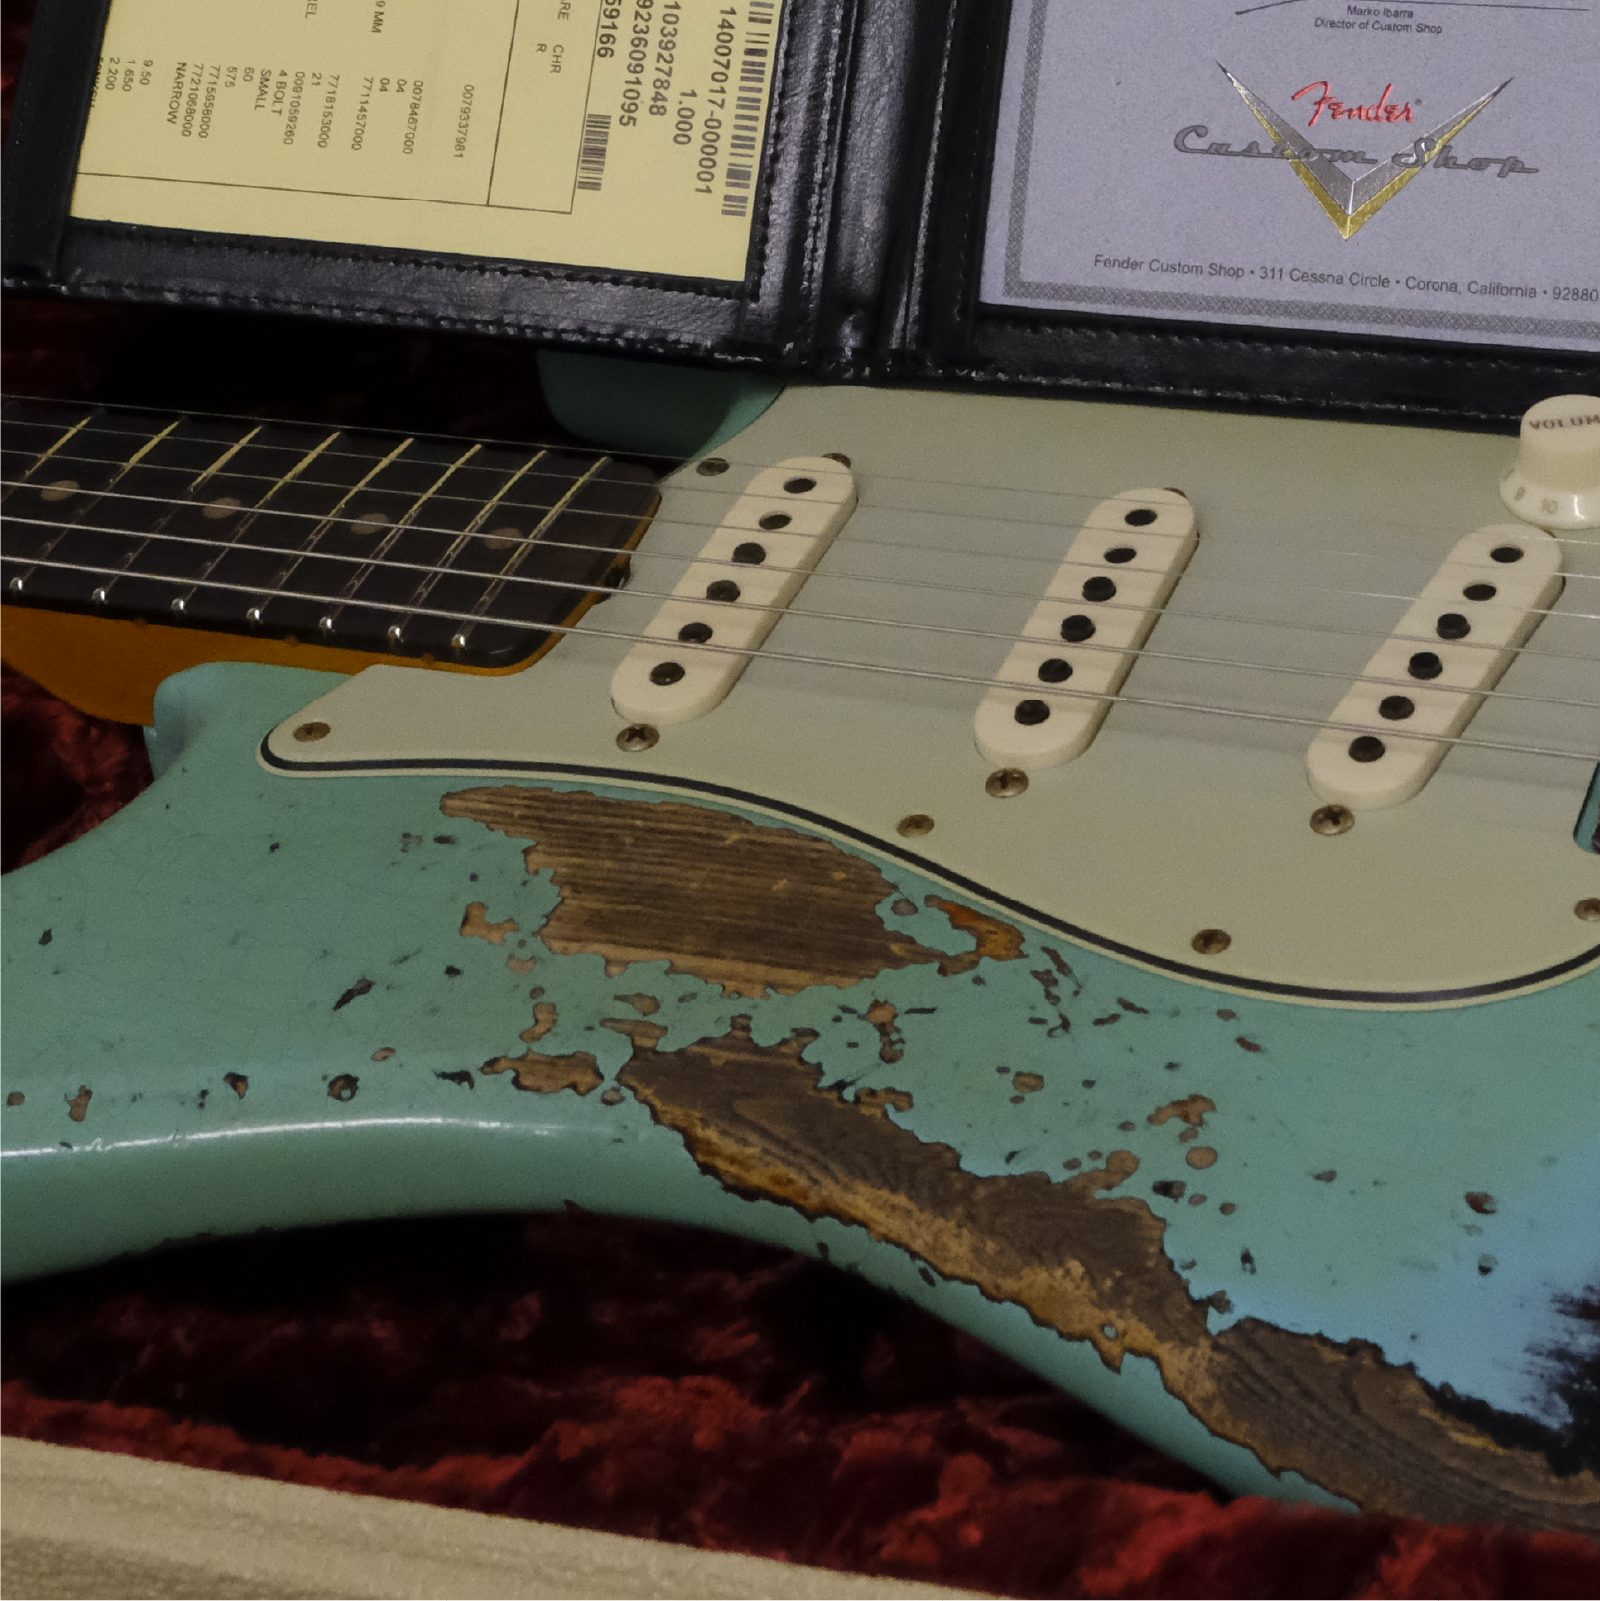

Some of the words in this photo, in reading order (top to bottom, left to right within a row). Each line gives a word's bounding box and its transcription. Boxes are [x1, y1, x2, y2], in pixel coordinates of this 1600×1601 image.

[1313, 16, 1356, 29] Director
[1357, 19, 1369, 29] of
[1371, 19, 1412, 32] Custom
[1346, 4, 1380, 16] Marko
[1382, 7, 1413, 18] Ibarra
[549, 43, 564, 73] CHR
[648, 0, 681, 116] 103927848
[672, 88, 698, 145] 1.000
[694, 6, 737, 194] 14007017-000001
[1173, 123, 1377, 166] Custom
[1391, 137, 1540, 177] Shop
[1093, 253, 1144, 270] Fender
[1148, 258, 1203, 275] Custom
[1207, 262, 1245, 281] Shop
[1258, 265, 1283, 281] 311
[1288, 267, 1343, 285] Cessna
[1348, 271, 1390, 288] Circle
[1466, 280, 1537, 298] California
[1552, 285, 1599, 302] 92880
